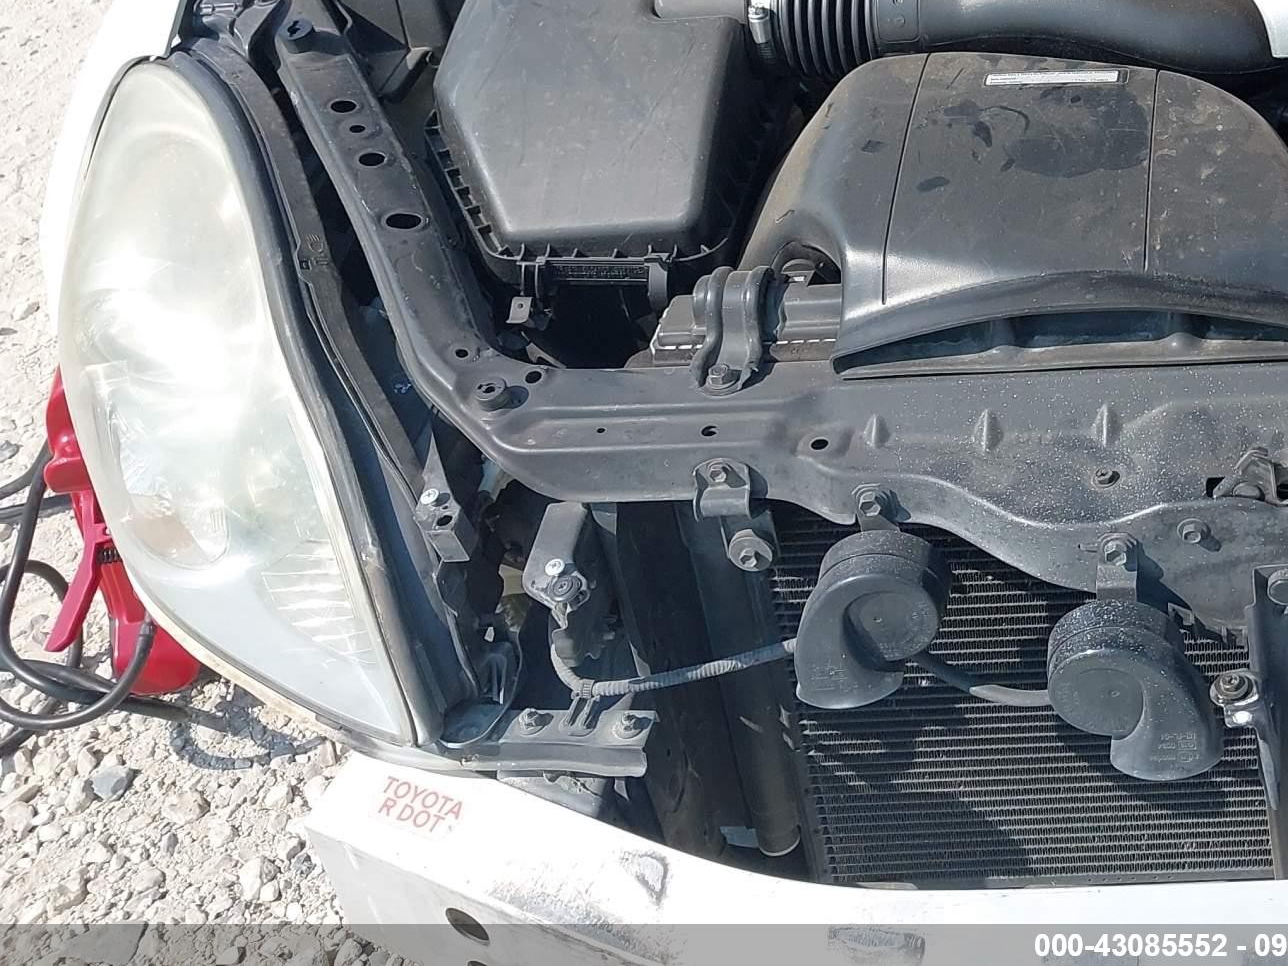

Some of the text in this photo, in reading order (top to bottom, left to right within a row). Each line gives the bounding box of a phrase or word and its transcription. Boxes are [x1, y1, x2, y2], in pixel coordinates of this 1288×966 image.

[377, 796, 446, 833] R DOT
[383, 775, 464, 821] TOYOTA
